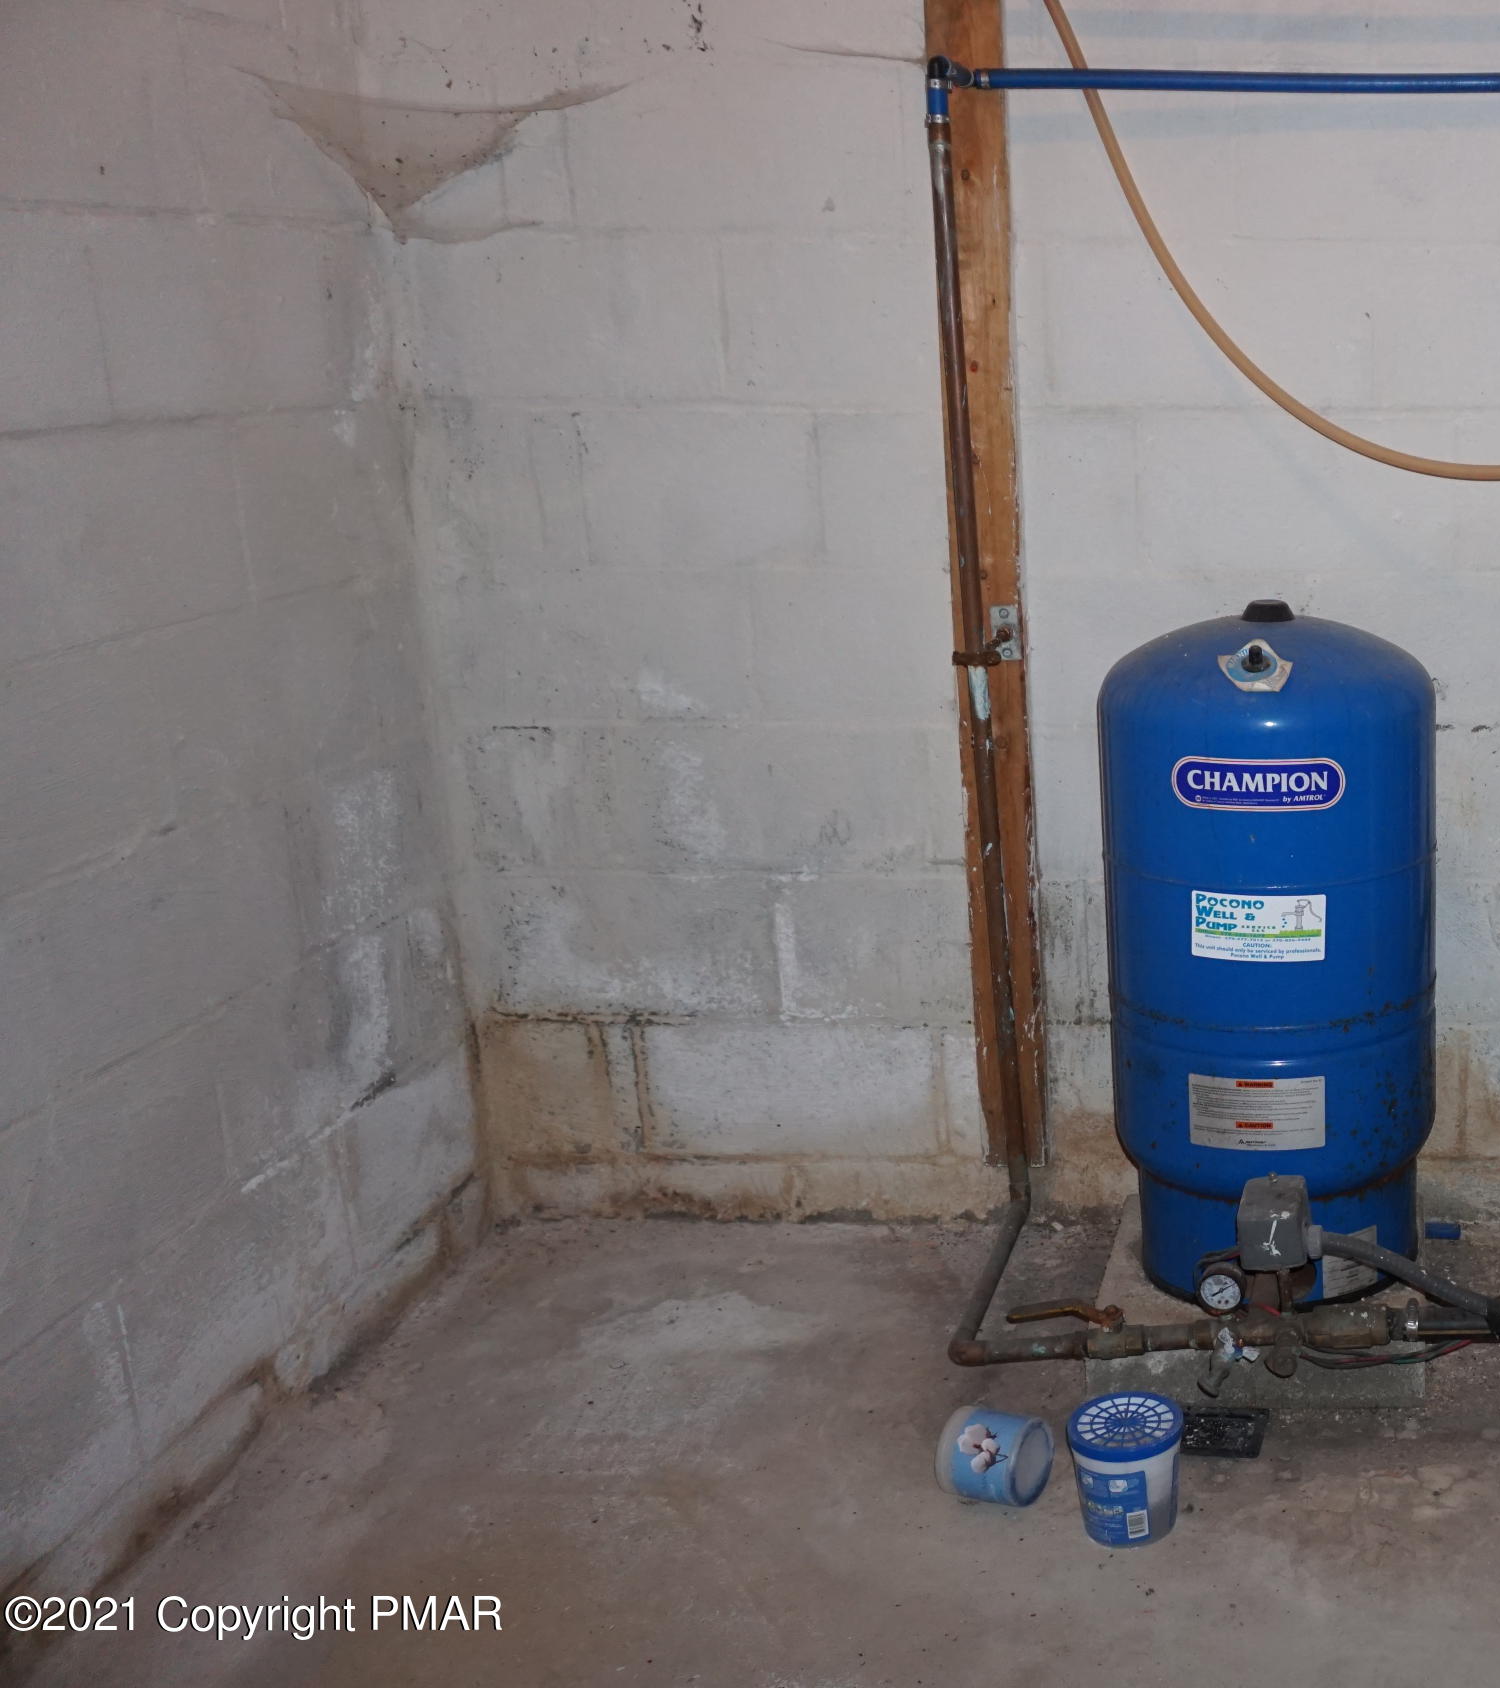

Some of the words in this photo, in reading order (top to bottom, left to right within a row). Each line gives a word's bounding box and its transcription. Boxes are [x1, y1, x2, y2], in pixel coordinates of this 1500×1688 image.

[1186, 769, 1329, 793] CHAMPION
[1282, 795, 1292, 804] by
[1195, 893, 1265, 910] POCONO
[1196, 904, 1238, 920] WELL
[1244, 912, 1256, 921] &
[1195, 916, 1238, 931] PUMP
